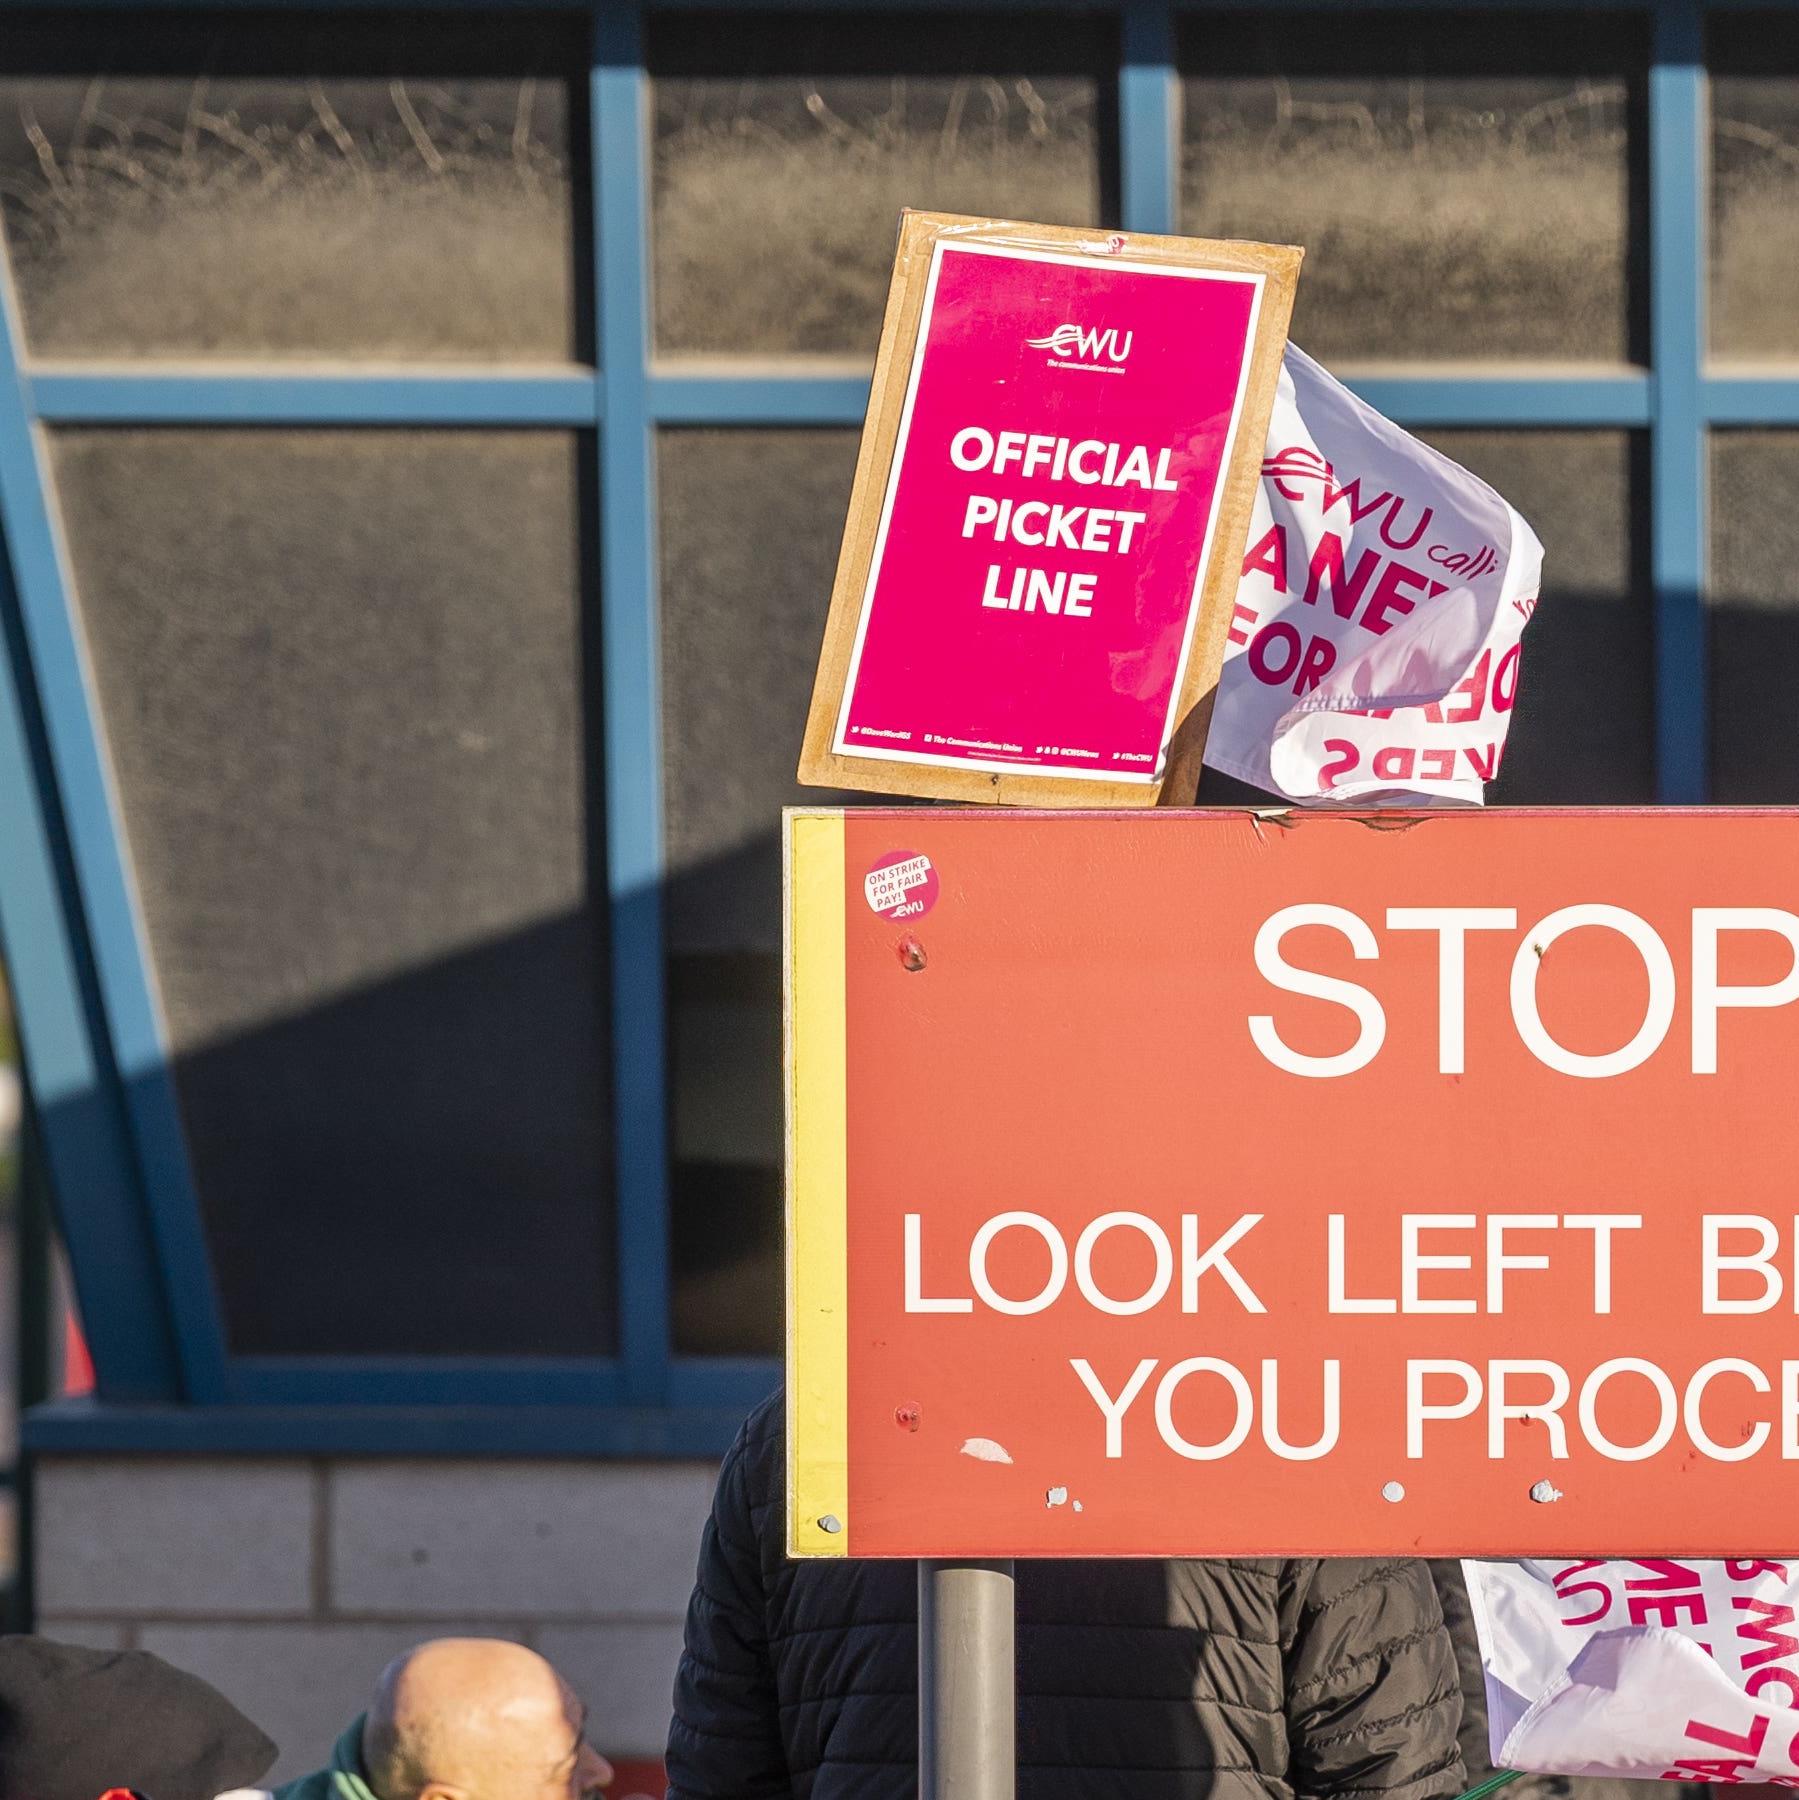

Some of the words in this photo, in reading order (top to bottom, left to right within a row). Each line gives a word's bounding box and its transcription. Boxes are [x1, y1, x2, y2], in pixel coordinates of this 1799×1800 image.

[1050, 323, 1133, 362] CWU
[950, 426, 1179, 492] OFFICIAL
[961, 495, 1147, 555] PICKET
[1273, 447, 1434, 550] CWU
[981, 564, 1098, 617] LINE
[869, 872, 886, 885] ON
[888, 858, 926, 878] STRIKE
[873, 882, 895, 897] FOR
[897, 872, 922, 888] FAIR
[877, 891, 902, 908] PAY!
[904, 1210, 1269, 1316] LOOK
[1327, 1213, 1643, 1314] LEFT
[1068, 1356, 1341, 1461] YOU
